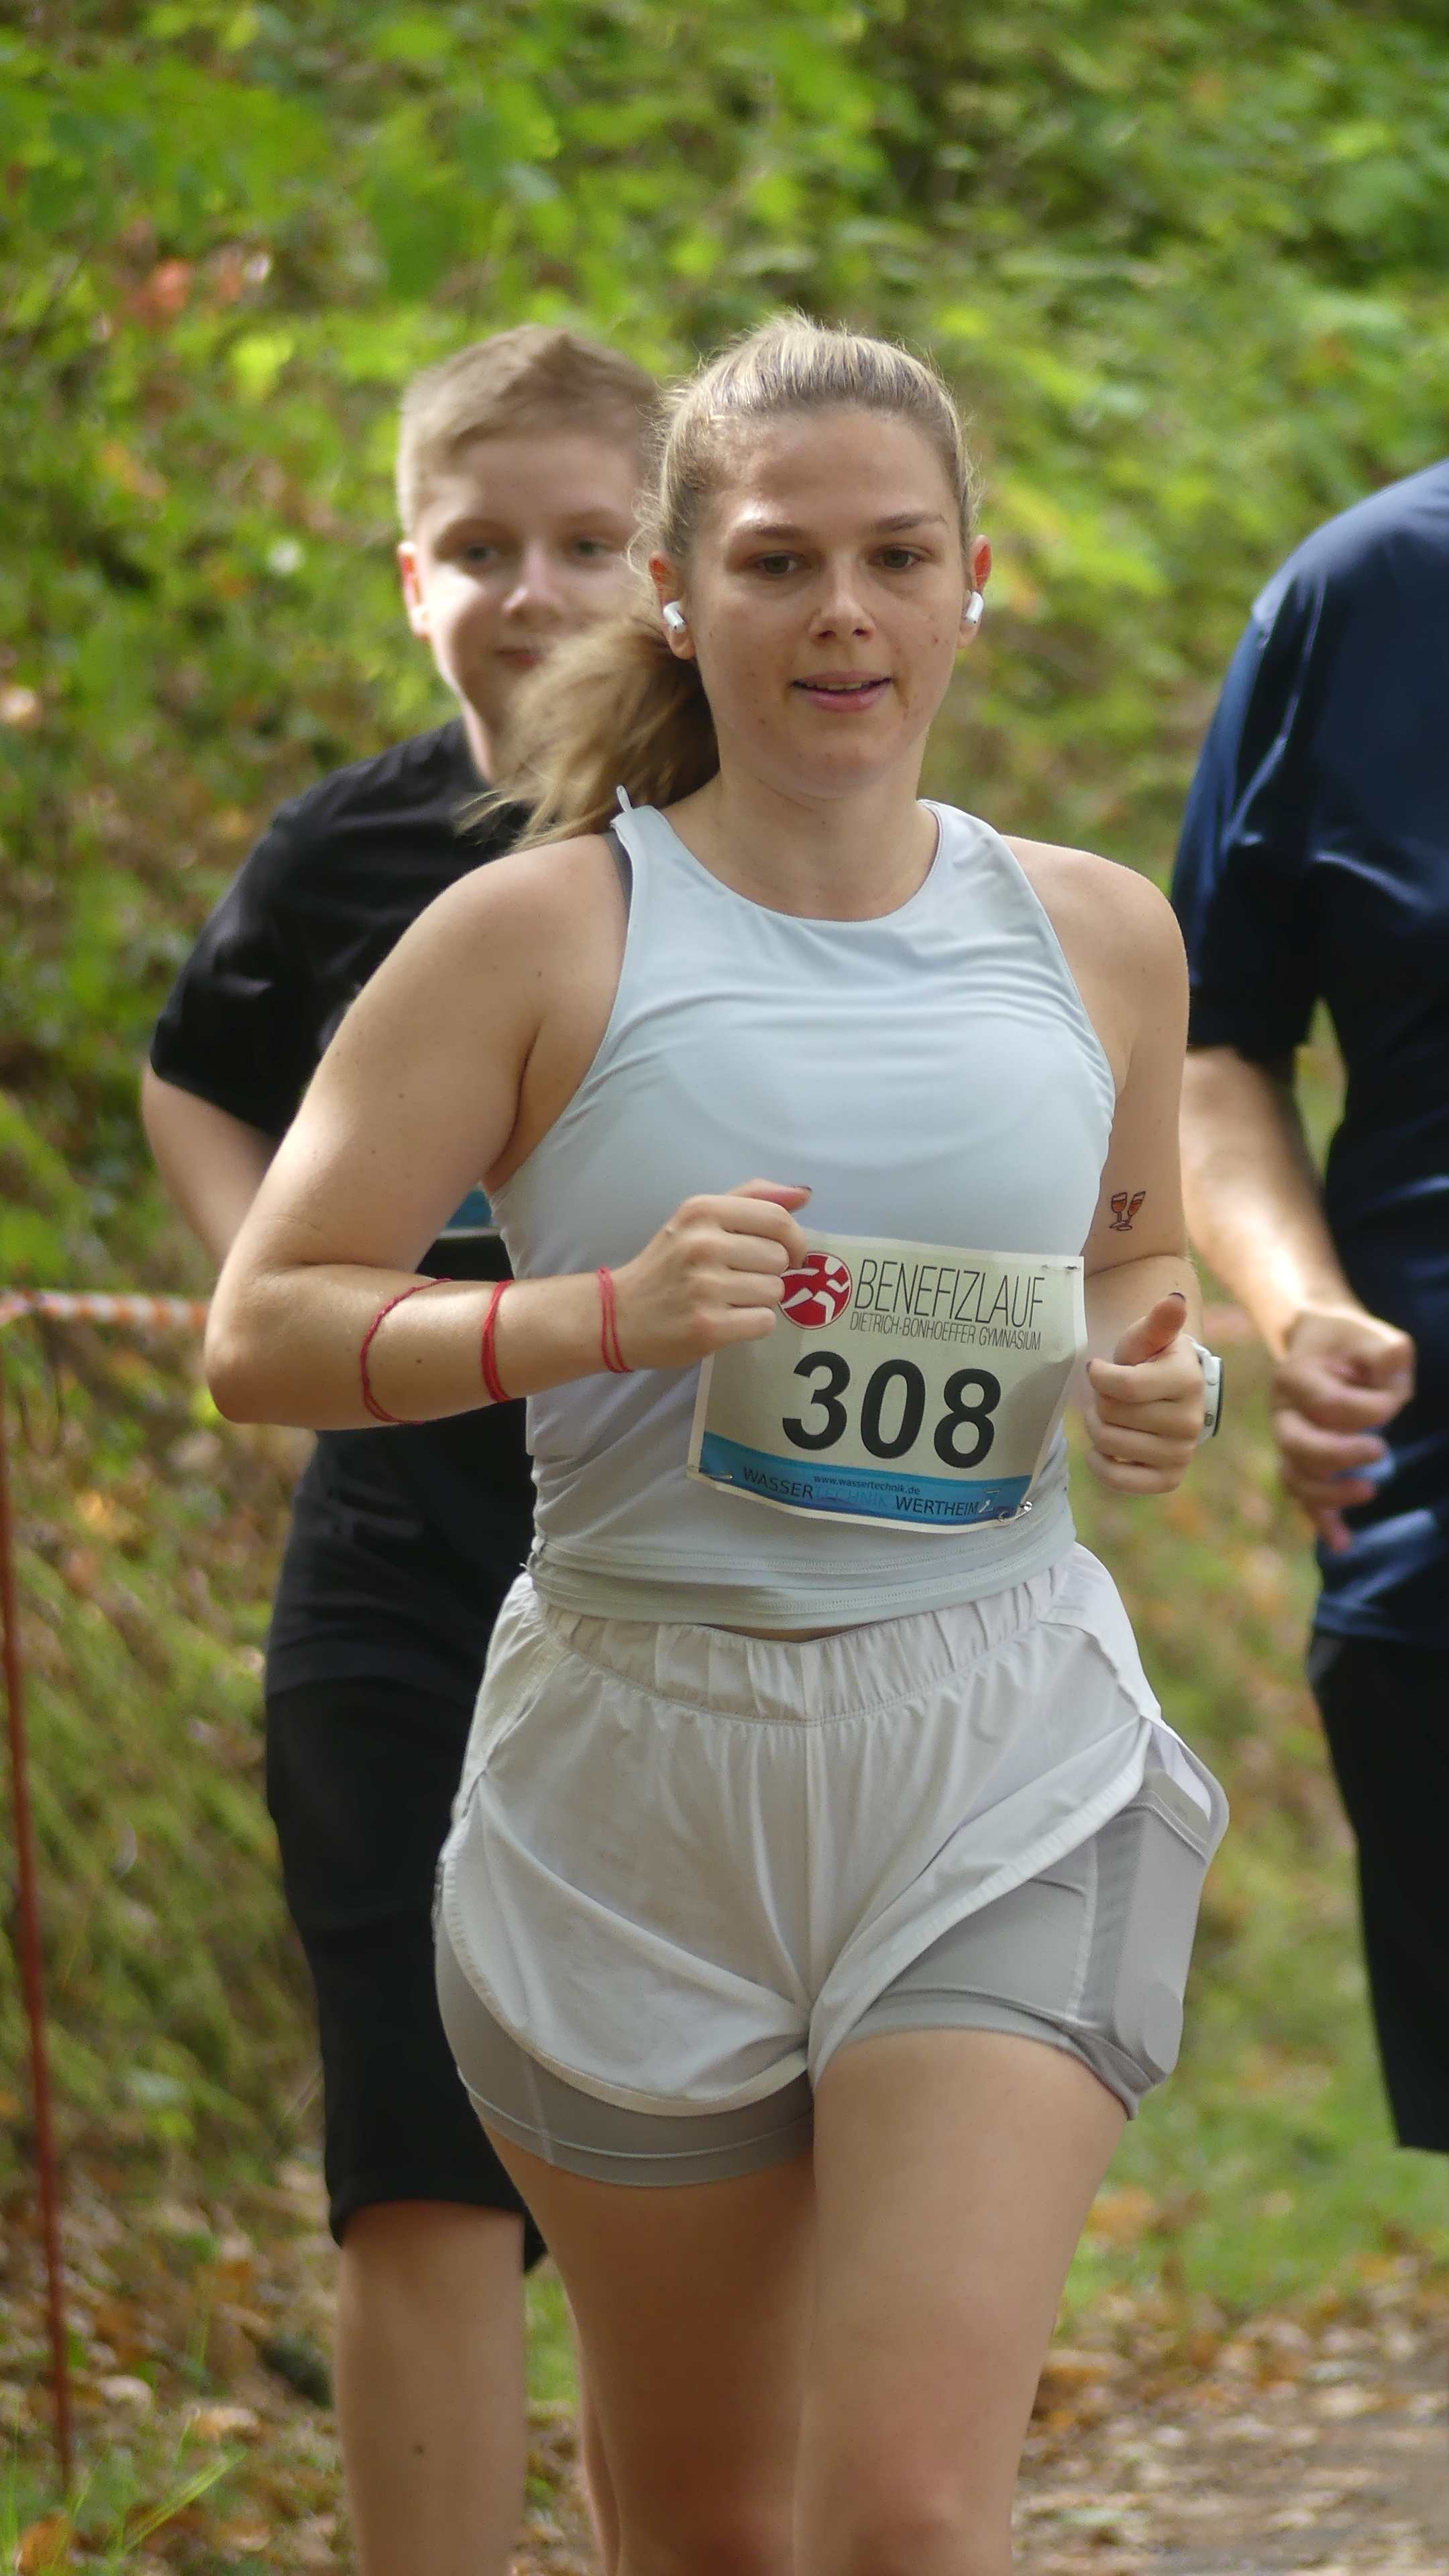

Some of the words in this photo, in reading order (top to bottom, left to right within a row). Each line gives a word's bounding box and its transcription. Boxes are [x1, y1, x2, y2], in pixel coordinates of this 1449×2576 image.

[854, 1258, 1045, 1328] BENEFIZLAUF
[849, 1311, 977, 1345] DIETRICH-BONHOEFFER
[978, 1326, 1042, 1350] GYMNASIUM
[782, 1350, 1002, 1468] 308
[813, 1475, 920, 1495] www.wassertechnik.de
[895, 1495, 980, 1516] WERTHEIM
